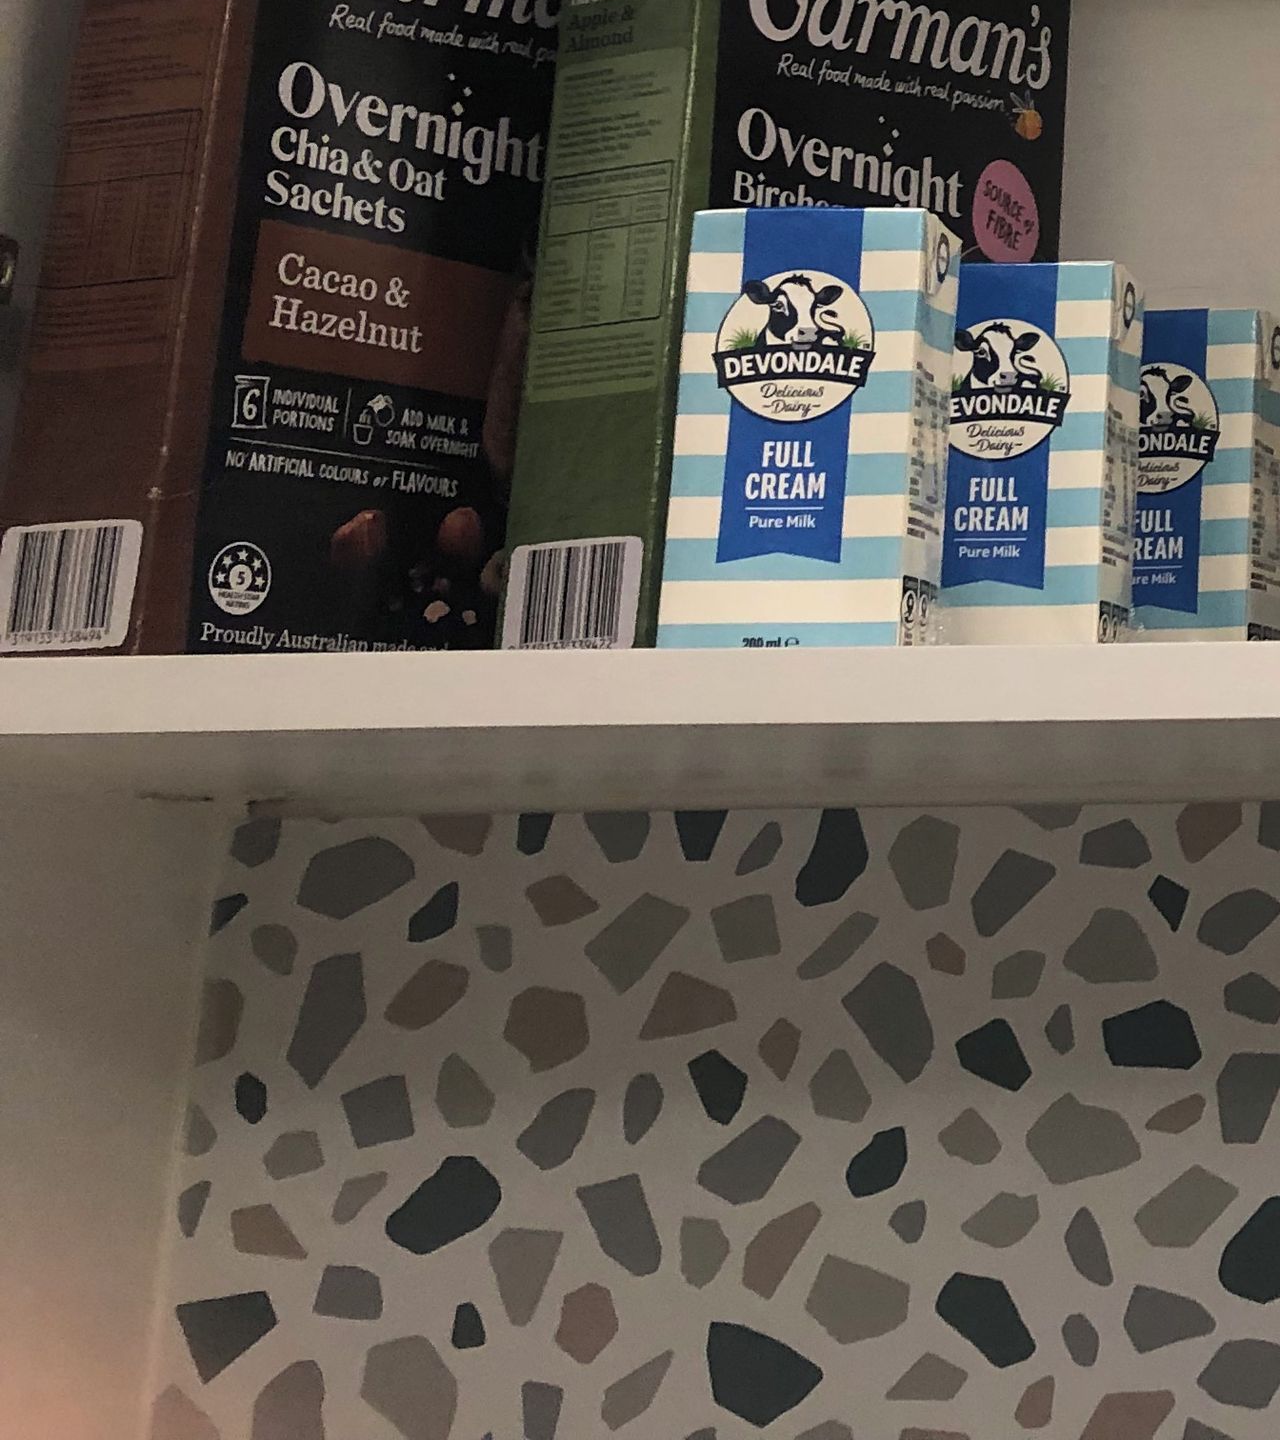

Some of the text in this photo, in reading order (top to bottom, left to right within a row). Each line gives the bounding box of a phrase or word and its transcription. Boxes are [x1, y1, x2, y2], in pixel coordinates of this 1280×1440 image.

[328, 4, 375, 33] Real
[376, 11, 420, 39] food
[420, 24, 465, 47] made
[467, 31, 499, 54] with
[776, 53, 1006, 112] Real food made with real passion
[278, 62, 544, 185] Overnight
[271, 126, 448, 202] Chia & Oat
[737, 108, 963, 219] Overnight
[265, 170, 406, 233] Sachets
[983, 179, 1025, 222] SOURCE
[986, 209, 1022, 250] FIBRE
[278, 252, 411, 308] Cacao &
[269, 295, 423, 354] Hazelnut
[723, 350, 865, 380] DEVONDALE
[242, 389, 260, 421] 6
[272, 389, 340, 414] INDIVIDUAL
[760, 383, 824, 400] Delicious
[272, 409, 335, 432] PORTIONS
[401, 408, 469, 435] ADD MILK &
[966, 423, 1025, 438] Delicious
[385, 429, 480, 459] SOAK OVERNIGHT
[761, 441, 815, 468] FULL
[225, 450, 459, 498] NO ARTIFICIAL COLOURS or FLAVOURS
[745, 472, 826, 499] CREAM
[969, 477, 1018, 502] FULL
[749, 514, 816, 529] Pure Milk
[954, 506, 1029, 531] CREAM
[958, 544, 1020, 558] Pure Milk
[235, 571, 246, 586] 5
[1151, 572, 1177, 584] Milk
[201, 622, 275, 650] Proudly
[276, 629, 368, 651] Australian
